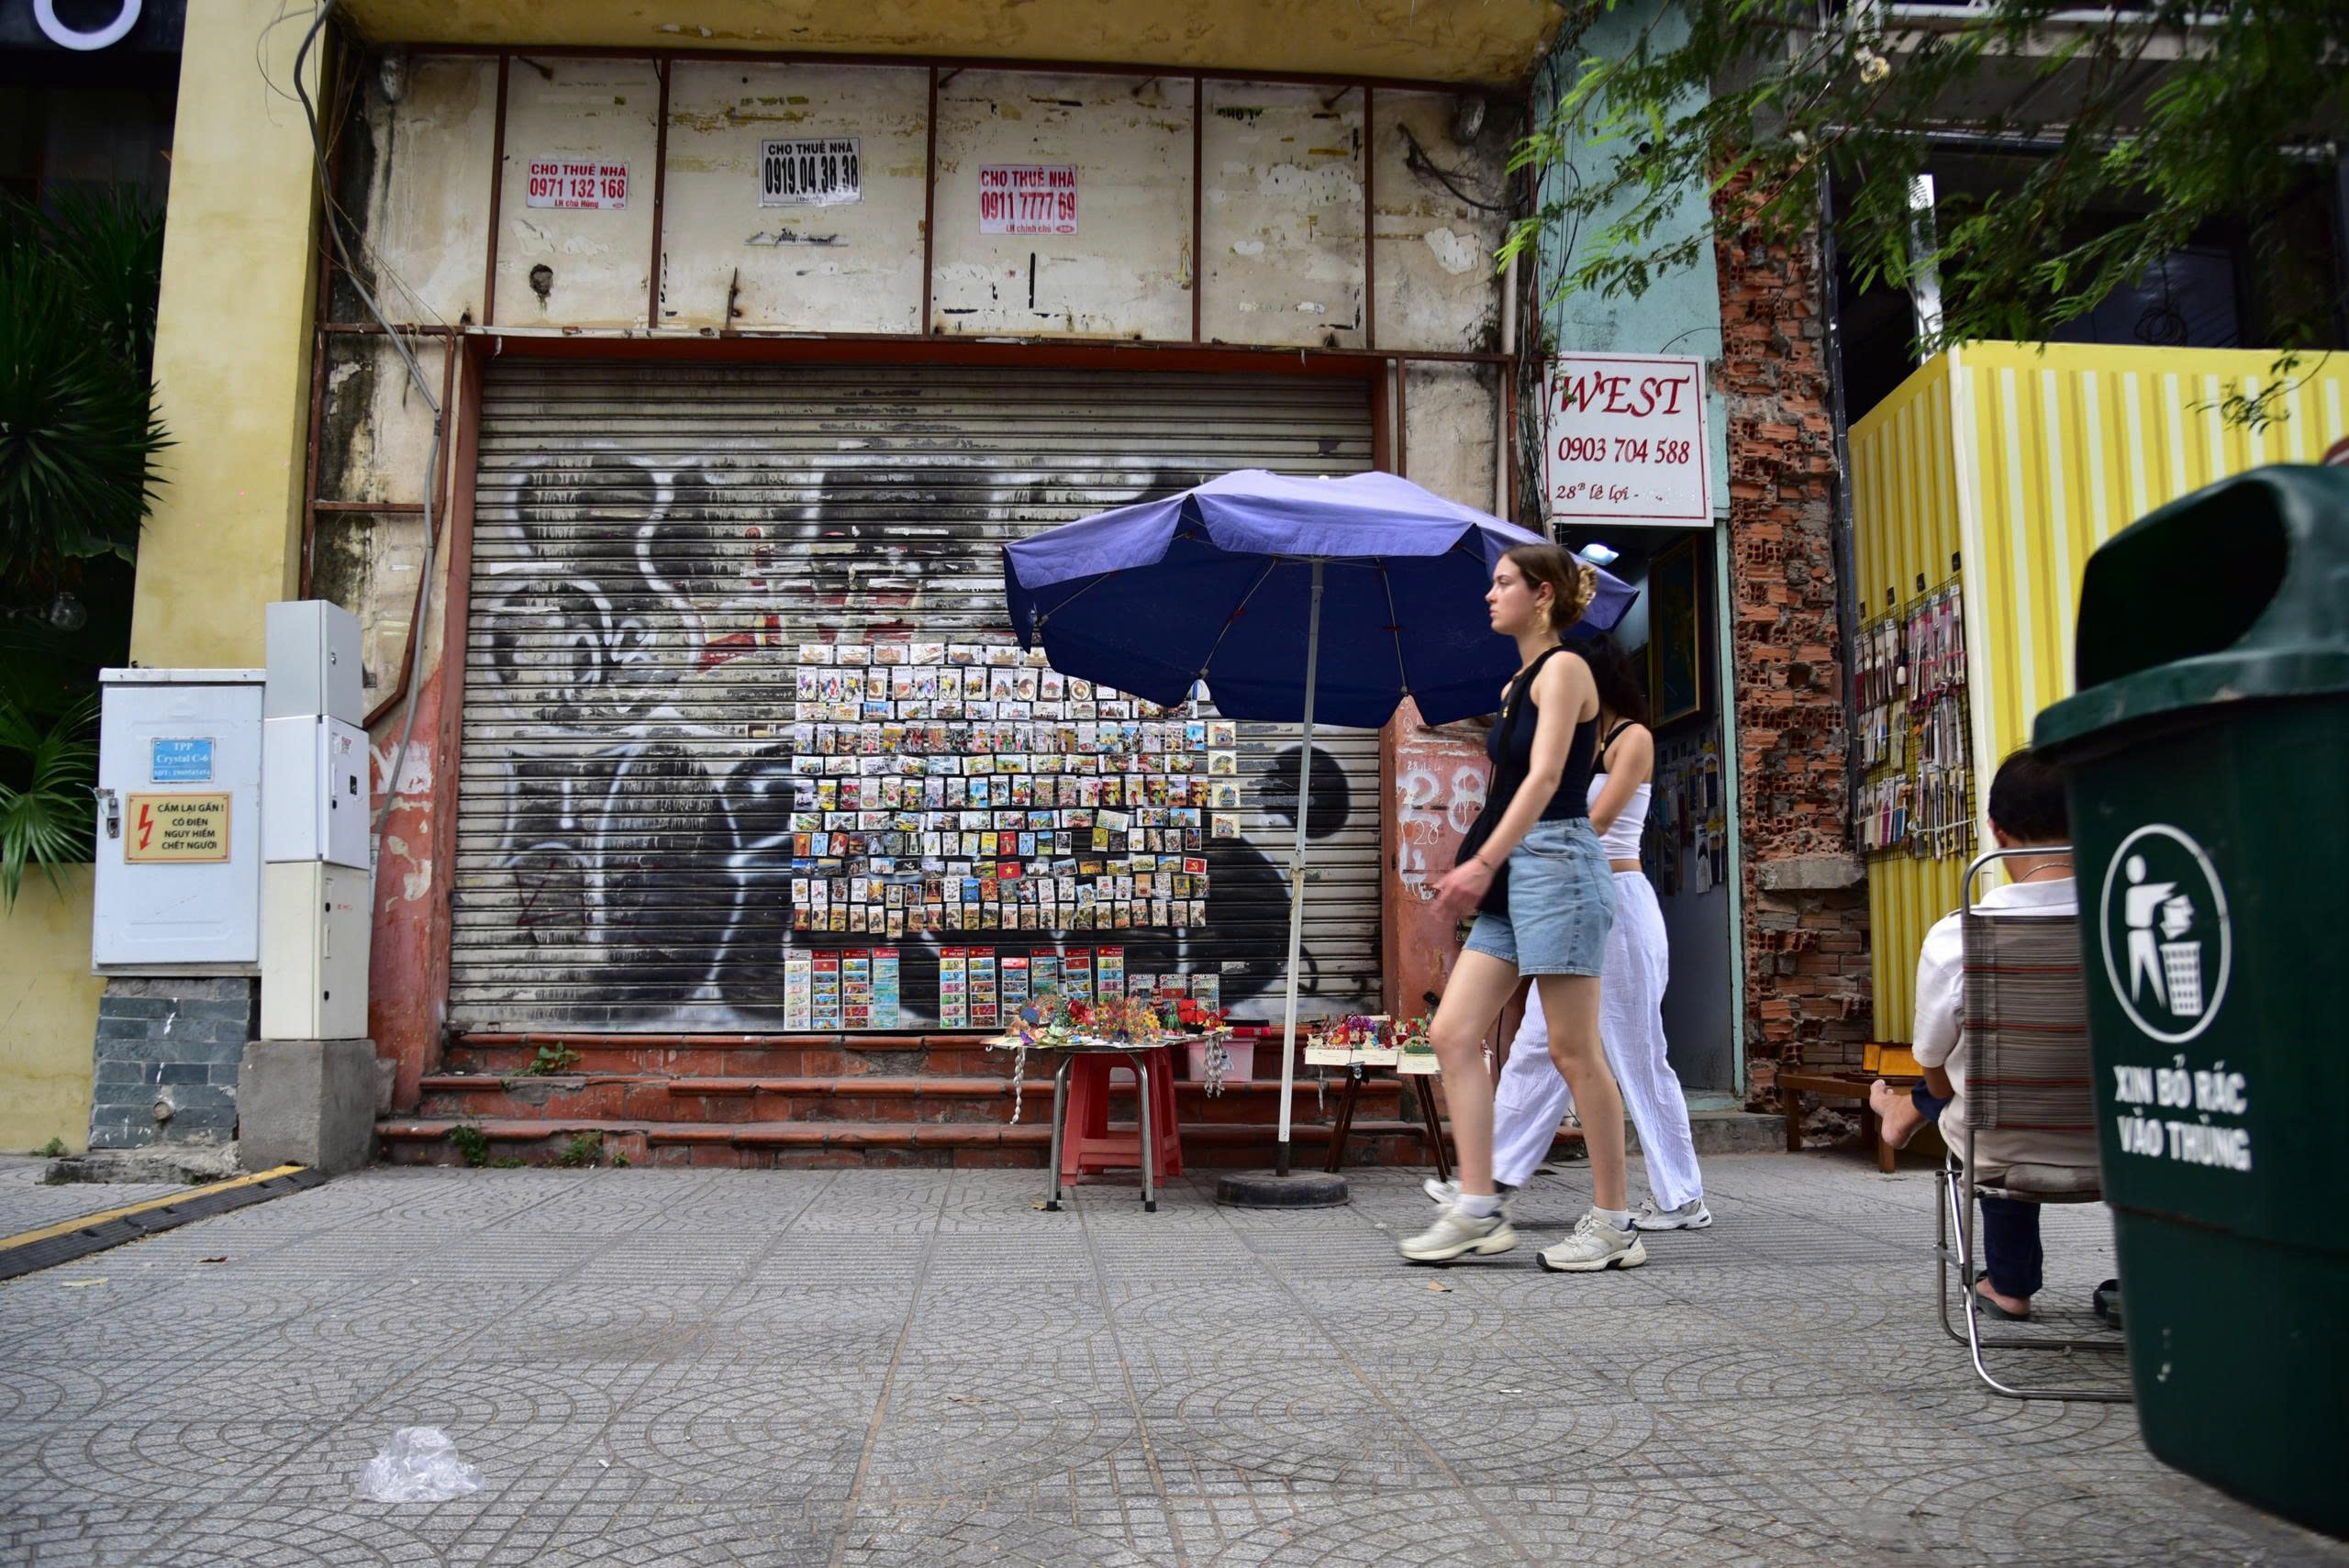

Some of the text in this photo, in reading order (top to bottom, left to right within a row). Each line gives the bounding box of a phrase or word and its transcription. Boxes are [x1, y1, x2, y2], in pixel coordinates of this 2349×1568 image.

[768, 144, 793, 155] CHO
[829, 139, 853, 153] NHÀ
[530, 162, 627, 176] CHO THUÊ NHÀ
[981, 167, 1075, 188] CHO THUÊ NHÀ
[529, 177, 625, 198] 0971 132 168
[981, 191, 1075, 220] 0911 7777 69
[1553, 371, 1690, 417] WEST
[1558, 436, 1690, 464] 0903 704 588
[173, 742, 194, 751] TPP
[156, 754, 209, 764] Crystal C-6
[157, 803, 179, 813] CẤM
[181, 805, 196, 815] LẠI
[198, 802, 219, 813] GẦN
[172, 817, 208, 828] CÓ ĐIỆN
[164, 828, 216, 839] NGUY HIỂM
[161, 840, 217, 850] CHẾT NGƯỜI
[2113, 1053, 2247, 1115] XIN BỎ RÁC
[2117, 1106, 2252, 1172] VÀO THÙNG
